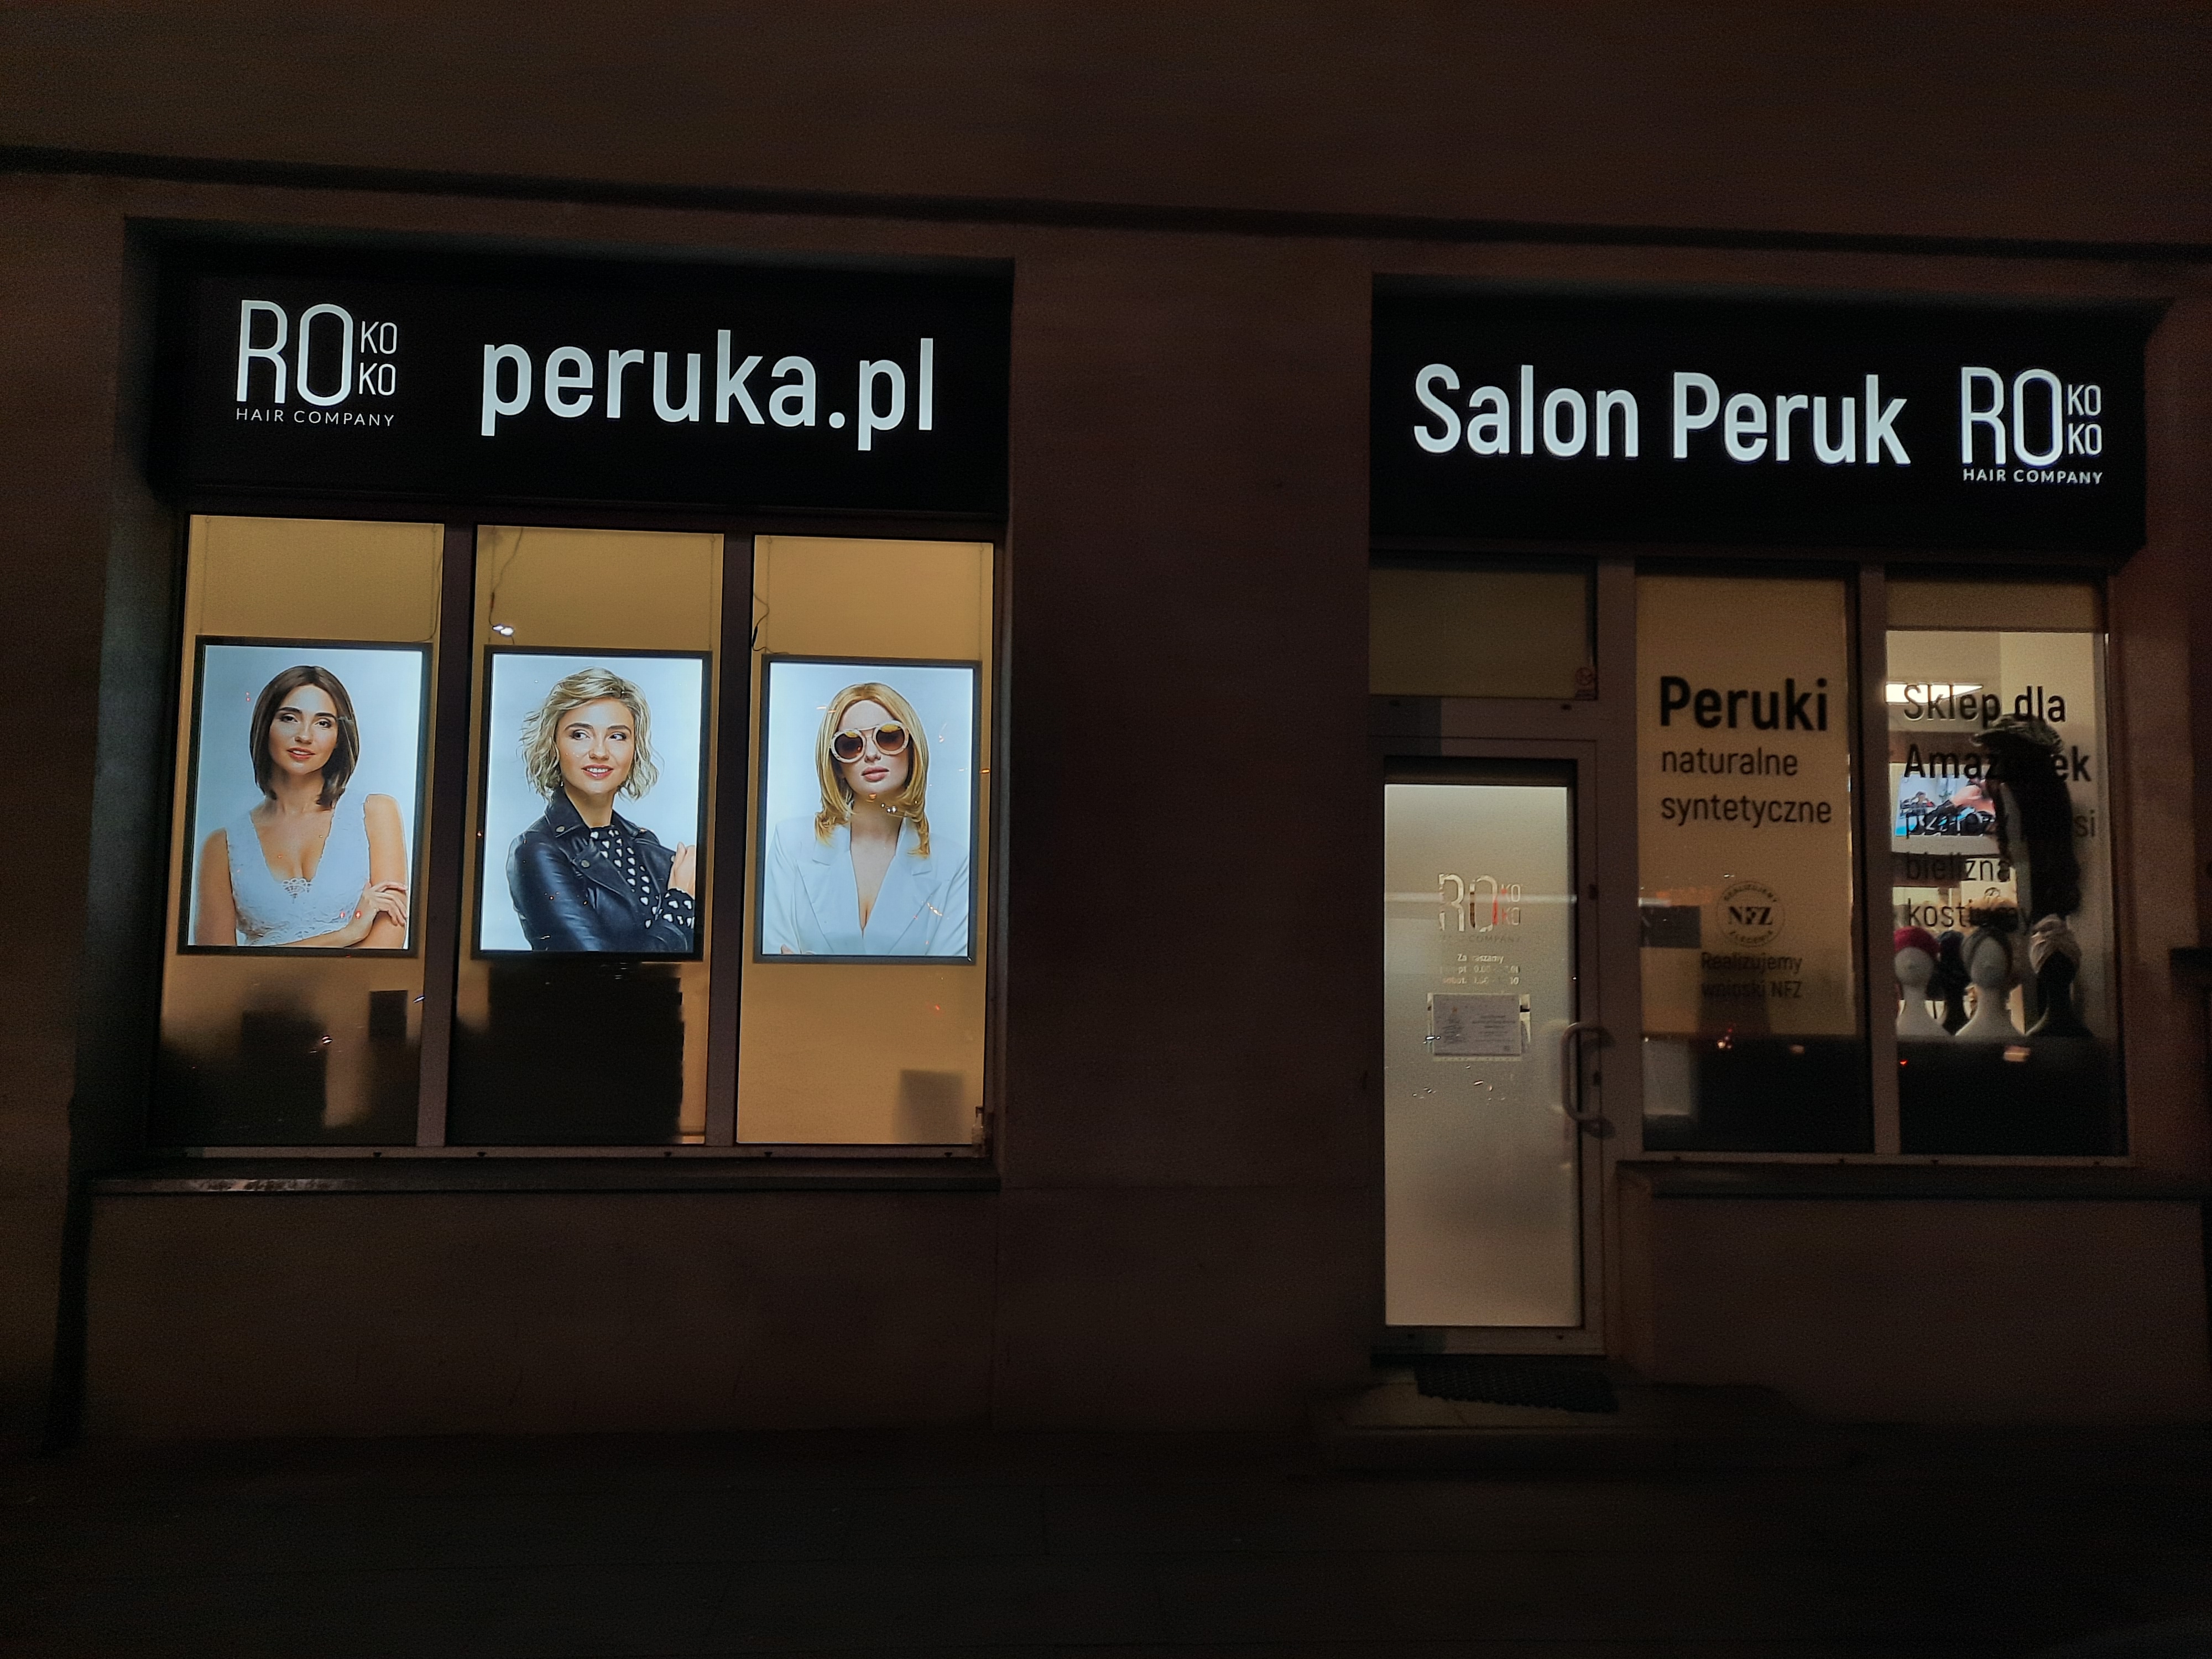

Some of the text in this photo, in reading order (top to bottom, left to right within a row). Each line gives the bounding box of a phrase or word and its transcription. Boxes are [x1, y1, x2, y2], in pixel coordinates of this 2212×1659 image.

[481, 329, 933, 451] peruka.pl
[236, 408, 394, 426] HAIR COMPANY
[1413, 363, 1911, 465] Salon Peruk
[1963, 468, 2103, 484] HAIR COMPANY
[1661, 676, 1827, 731] Peruki
[1904, 684, 2065, 727] Sklep dla
[1662, 748, 1797, 775] naturalne
[1904, 744, 2091, 781] Amazek
[1661, 795, 1831, 828] syntetyczne
[1728, 906, 1773, 925] NFZ
[1702, 951, 1803, 974] Realizujemy
[1770, 980, 1803, 998] NFZ
